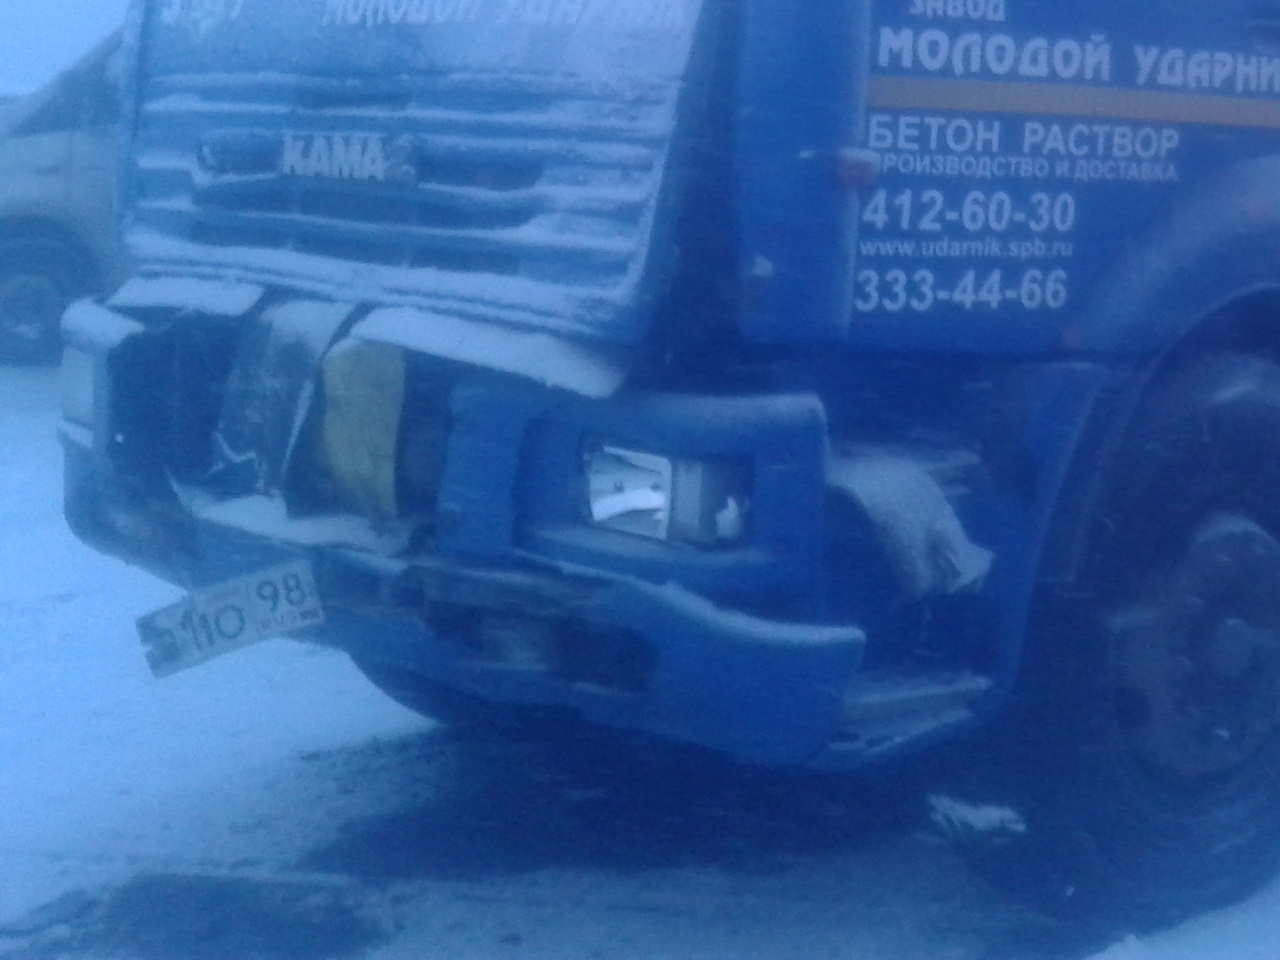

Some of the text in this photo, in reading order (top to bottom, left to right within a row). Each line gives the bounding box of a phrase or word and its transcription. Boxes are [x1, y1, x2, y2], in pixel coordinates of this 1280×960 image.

[877, 26, 1111, 81] МОЛОДОЙ
[868, 114, 1180, 159] БЕТОН РАСТВОР
[879, 152, 1179, 182] РОИЗВОДСТВО И ДОСТАВКА
[862, 189, 1076, 232] 412-60-30
[859, 237, 1074, 259] www.udarnik.spb.ru
[854, 268, 1068, 312] 333-44-66
[255, 572, 307, 613] 98
